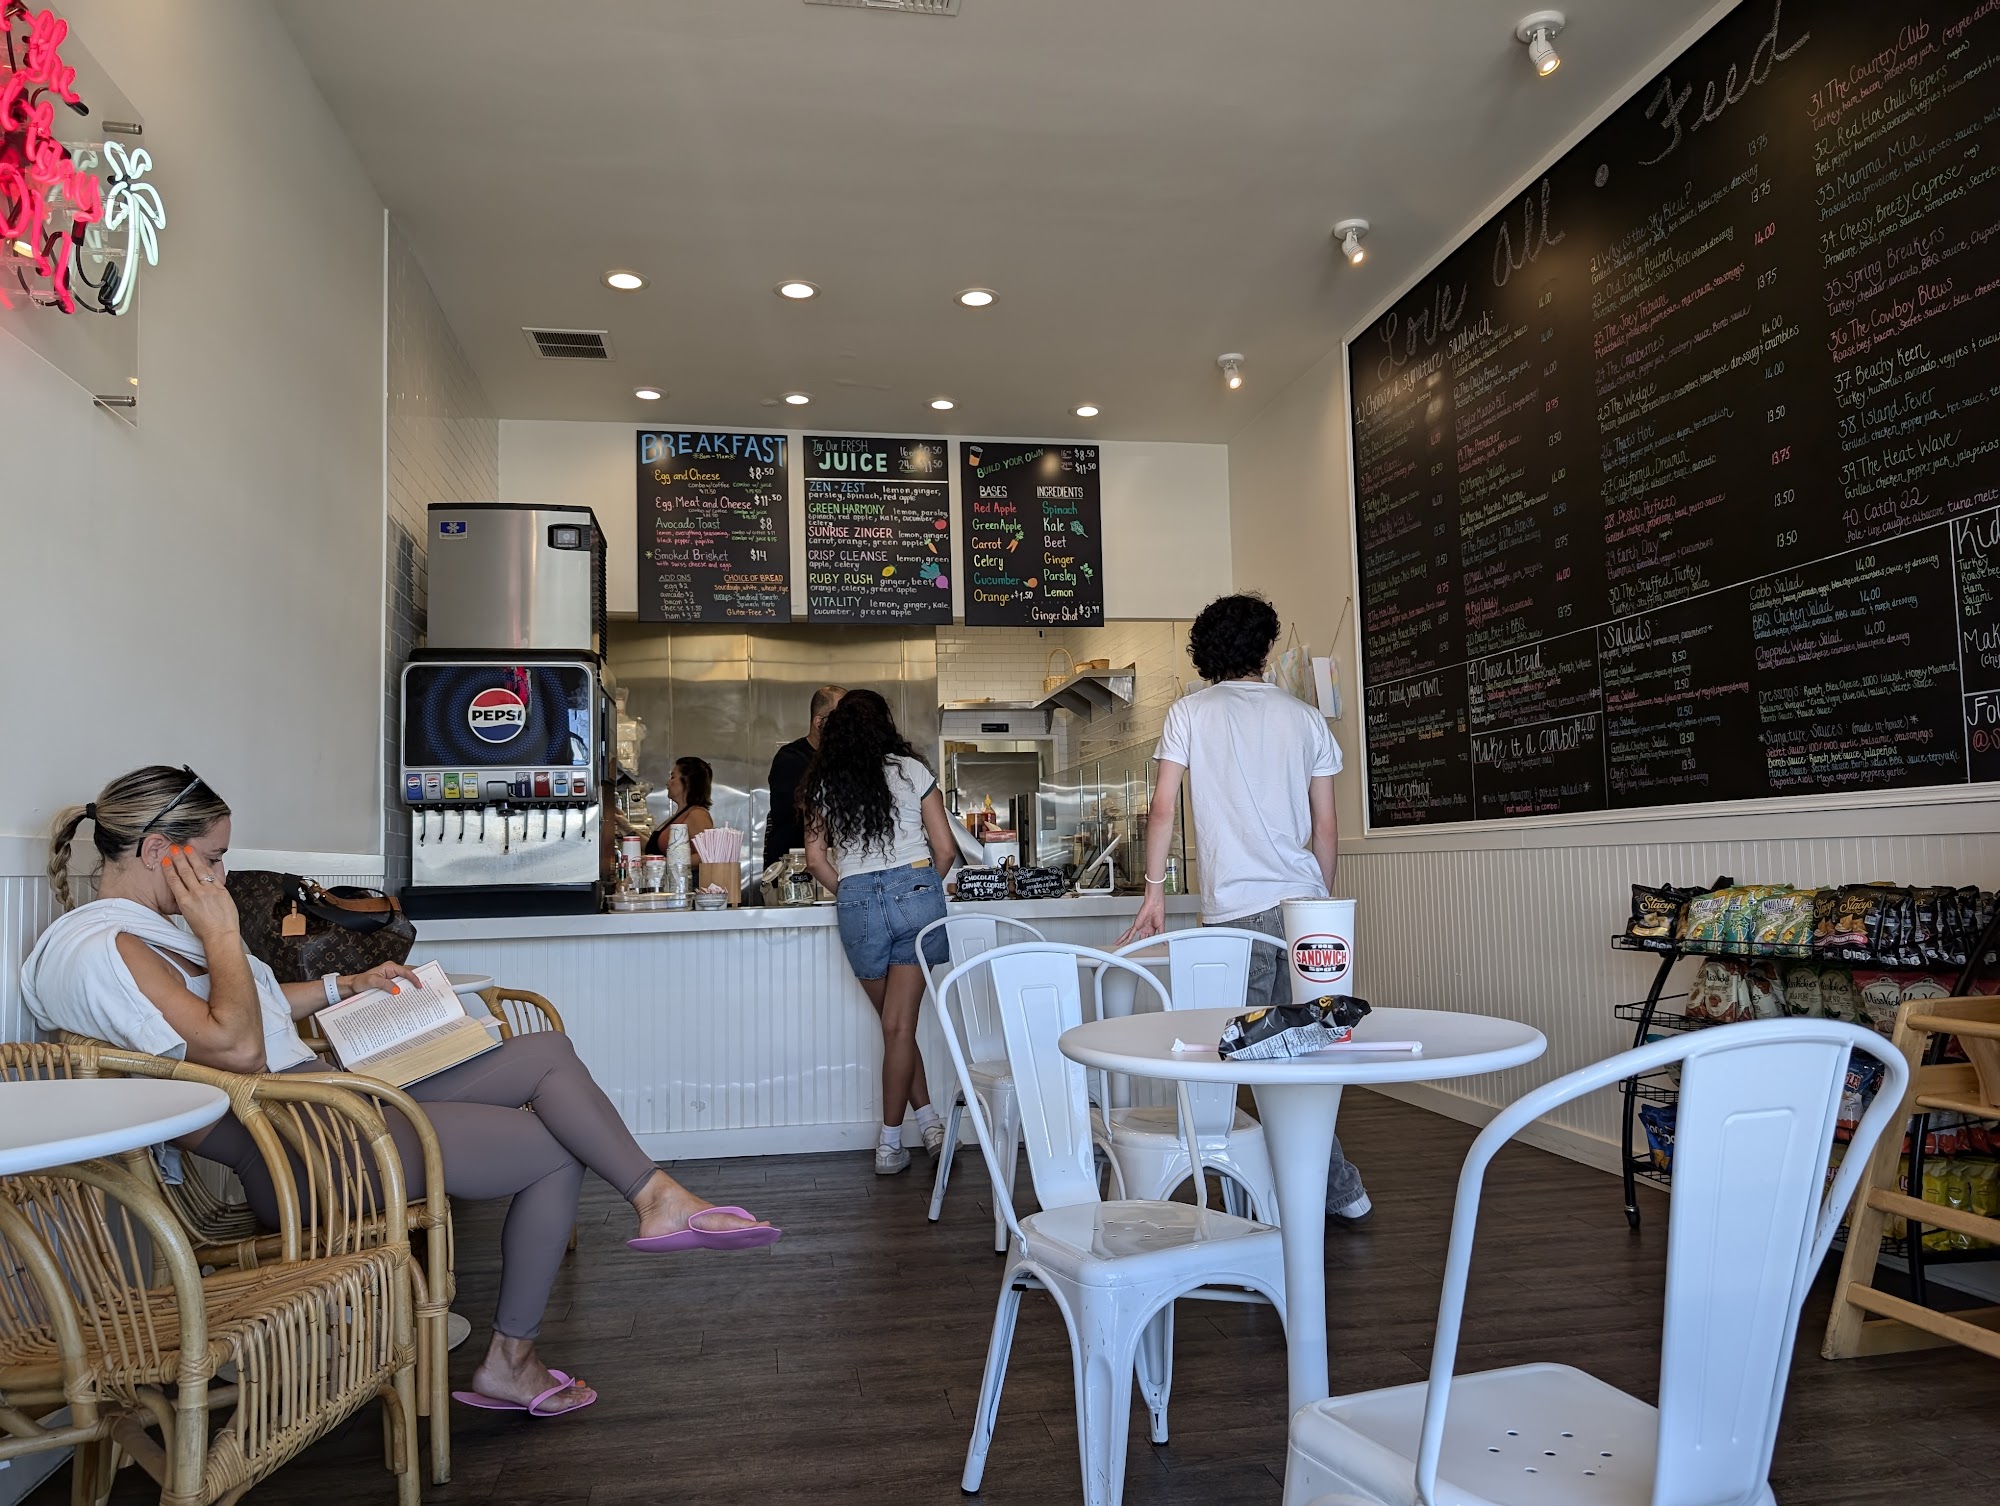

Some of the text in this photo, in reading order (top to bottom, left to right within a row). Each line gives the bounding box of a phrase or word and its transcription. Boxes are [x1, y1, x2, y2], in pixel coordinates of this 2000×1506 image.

[1825, 78, 1849, 103] The
[1849, 43, 1898, 84] Country
[1899, 17, 1929, 51] Club
[1638, 0, 1810, 165] Feed
[1837, 121, 1862, 147] Red
[1862, 107, 1884, 130] Hot
[1906, 64, 1948, 100] Peppers
[1837, 158, 1887, 195] Mamma
[1888, 134, 1927, 163] Mia
[1912, 164, 1964, 201] Caprese
[1842, 260, 1882, 293] Spring
[1886, 226, 1945, 269] Breakers
[1847, 318, 1870, 341] The
[1871, 298, 1914, 327] Cowboy
[1917, 278, 1953, 306] Bleus
[1377, 281, 1468, 382] Love
[1834, 344, 1930, 394] 37. Beachy Keen
[1861, 399, 1902, 428] Island
[1902, 387, 1935, 412] Fever
[641, 434, 786, 467] BREAKFAST
[825, 440, 838, 451] Our
[841, 441, 869, 452] FRESH
[1857, 456, 1881, 477] The
[1883, 444, 1916, 468] Heat
[1917, 429, 1962, 456] Wave
[819, 452, 888, 473] JUICE
[1074, 448, 1095, 461] $8.50
[977, 449, 1044, 478] BUILD YOUR OWN
[655, 466, 774, 485] Egg and Cheese $8.50
[808, 492, 845, 502] parsley,
[847, 492, 882, 501] spinach,
[809, 482, 941, 496] ZEN ZEST lemon, ginger,
[979, 486, 1084, 498] BASES INGREDIENTS
[675, 496, 700, 508] Meat
[703, 499, 718, 509] and
[720, 496, 752, 509] Cheese
[754, 494, 782, 506] $11.50
[808, 503, 840, 514] GREEN
[844, 504, 886, 515] HARMONY
[974, 502, 1017, 516] Red Apple
[1042, 501, 1077, 518] Spinach
[1842, 487, 1929, 527] 40. Catch 22
[655, 517, 773, 531] Avocado Toast $8
[972, 518, 1022, 534] Green Apple
[1043, 518, 1065, 532] Kale
[808, 527, 849, 538] SUNRISE
[854, 528, 893, 539] ZINGER
[898, 531, 922, 540] lemon,
[1044, 535, 1067, 548] Beet
[808, 538, 924, 550] carrot, orange, green apple
[972, 537, 1002, 550] Carrot
[654, 549, 767, 562] Smoked Brisket $14
[808, 550, 949, 565] CRISP CLEANSE lemon, green
[974, 554, 1004, 571] Celery
[1044, 552, 1075, 568] Ginger
[809, 561, 860, 571] apple, celery
[809, 573, 935, 587] RUBY RUSH ginger, beet,
[974, 572, 1021, 585] Cucumber
[1043, 569, 1077, 586] Parsley
[841, 585, 869, 594] celery,
[870, 585, 894, 594] green
[896, 586, 917, 595] apple
[974, 589, 1010, 607] Orange
[1044, 585, 1074, 597] Lemon
[810, 597, 931, 611] VITALITY lemon, ginger,
[814, 609, 912, 618] cucumber, green apple
[1031, 607, 1060, 623] Ginger
[1061, 605, 1079, 621] Shot
[1480, 660, 1505, 681] Choose
[1507, 659, 1513, 675] a
[472, 710, 522, 721] PEPSI
[1472, 737, 1507, 771] Make
[1526, 734, 1536, 754] a
[973, 888, 993, 896] $3.75
[1296, 950, 1347, 967] SANDWICH
